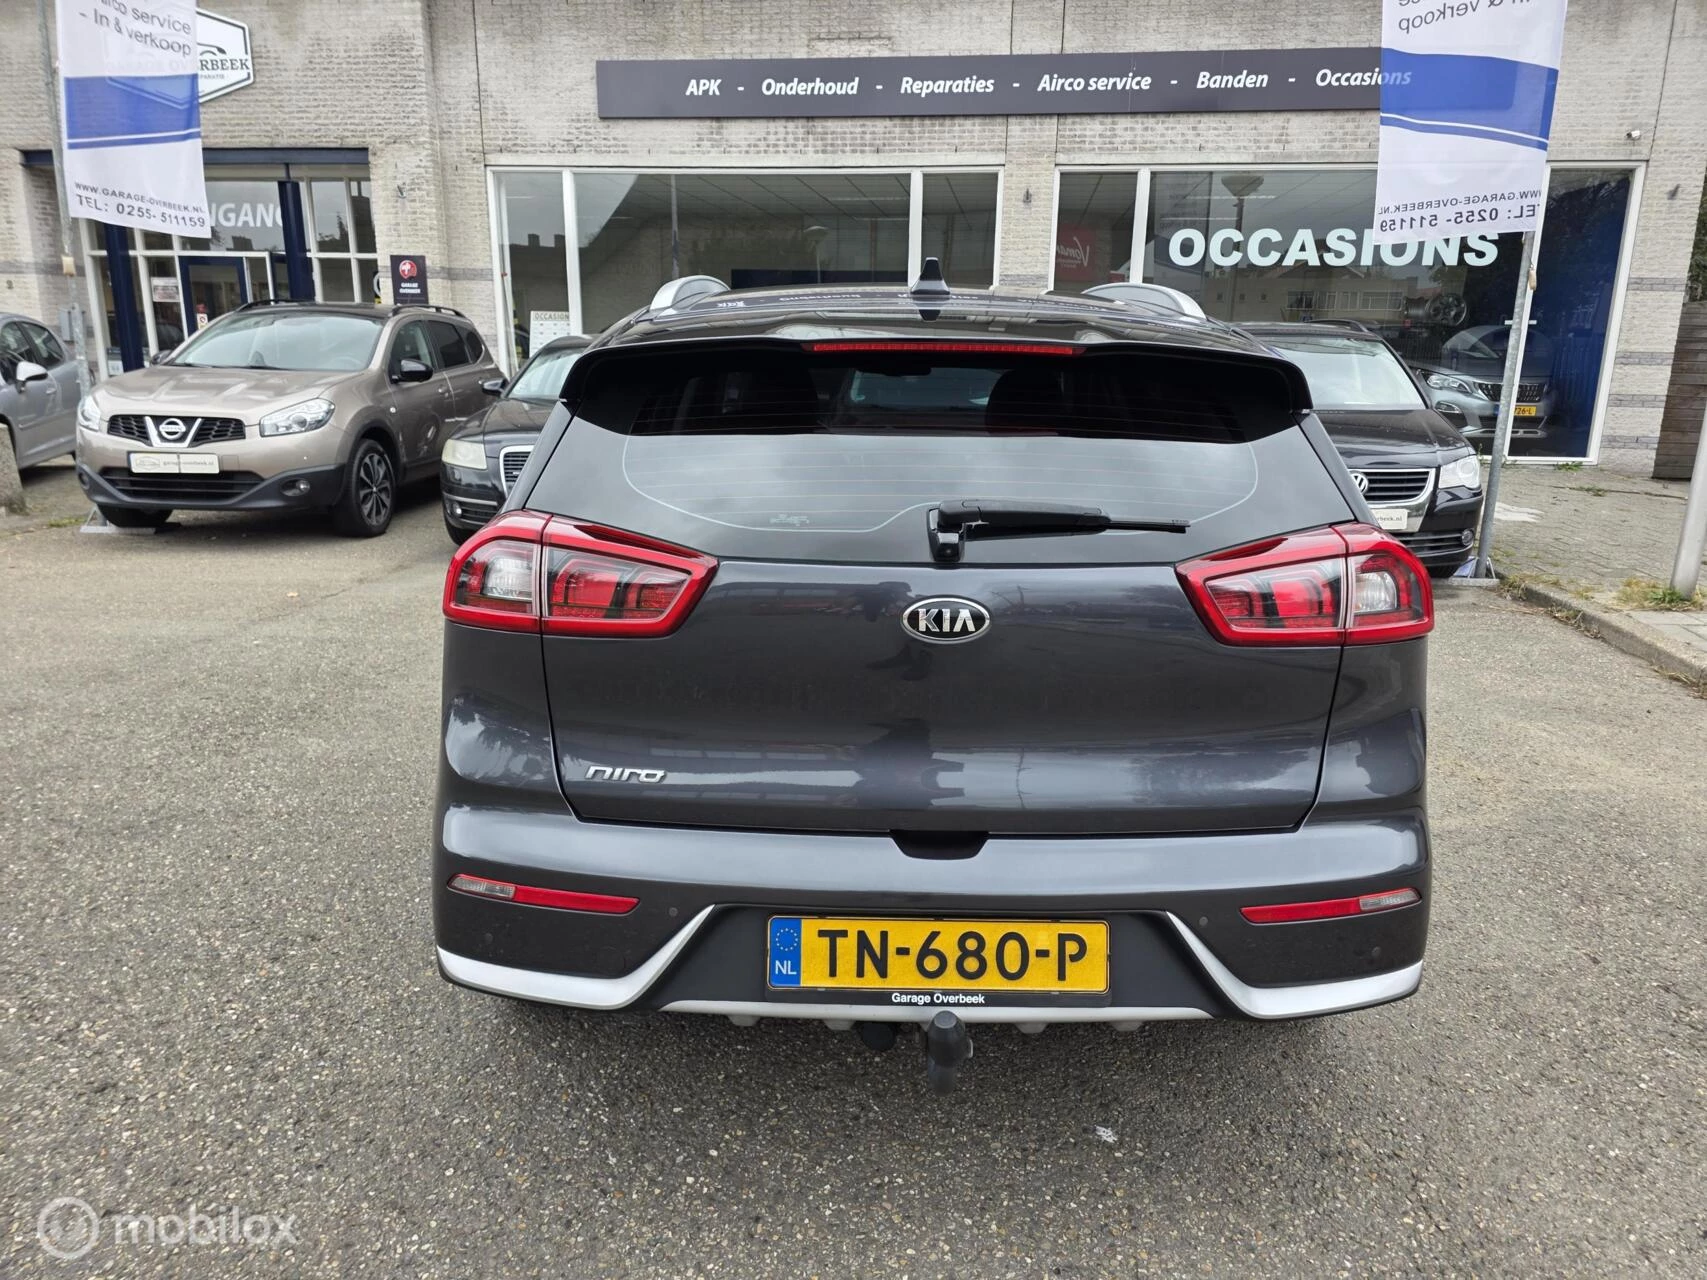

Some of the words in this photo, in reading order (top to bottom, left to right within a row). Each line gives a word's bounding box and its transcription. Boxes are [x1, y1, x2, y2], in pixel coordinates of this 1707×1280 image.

[94, 9, 110, 27] In
[114, 18, 124, 34] &
[126, 24, 192, 57] verkoop
[132, 8, 191, 35] service
[686, 79, 721, 96] APK
[761, 77, 859, 96] Onderhoud
[900, 75, 995, 97] Reparaties
[1037, 73, 1084, 92] Airco
[1088, 72, 1151, 91] service
[1196, 71, 1268, 89] Banden
[1315, 67, 1412, 87] Occasions
[76, 194, 109, 212] TEL:
[161, 212, 205, 228] 511159
[1168, 228, 1499, 267] OCCASIONS
[917, 608, 976, 632] KIA
[775, 960, 797, 975] NL
[817, 929, 1087, 982] TN-680-P
[892, 993, 931, 1005] Garage
[933, 993, 985, 1004] Overbeek
